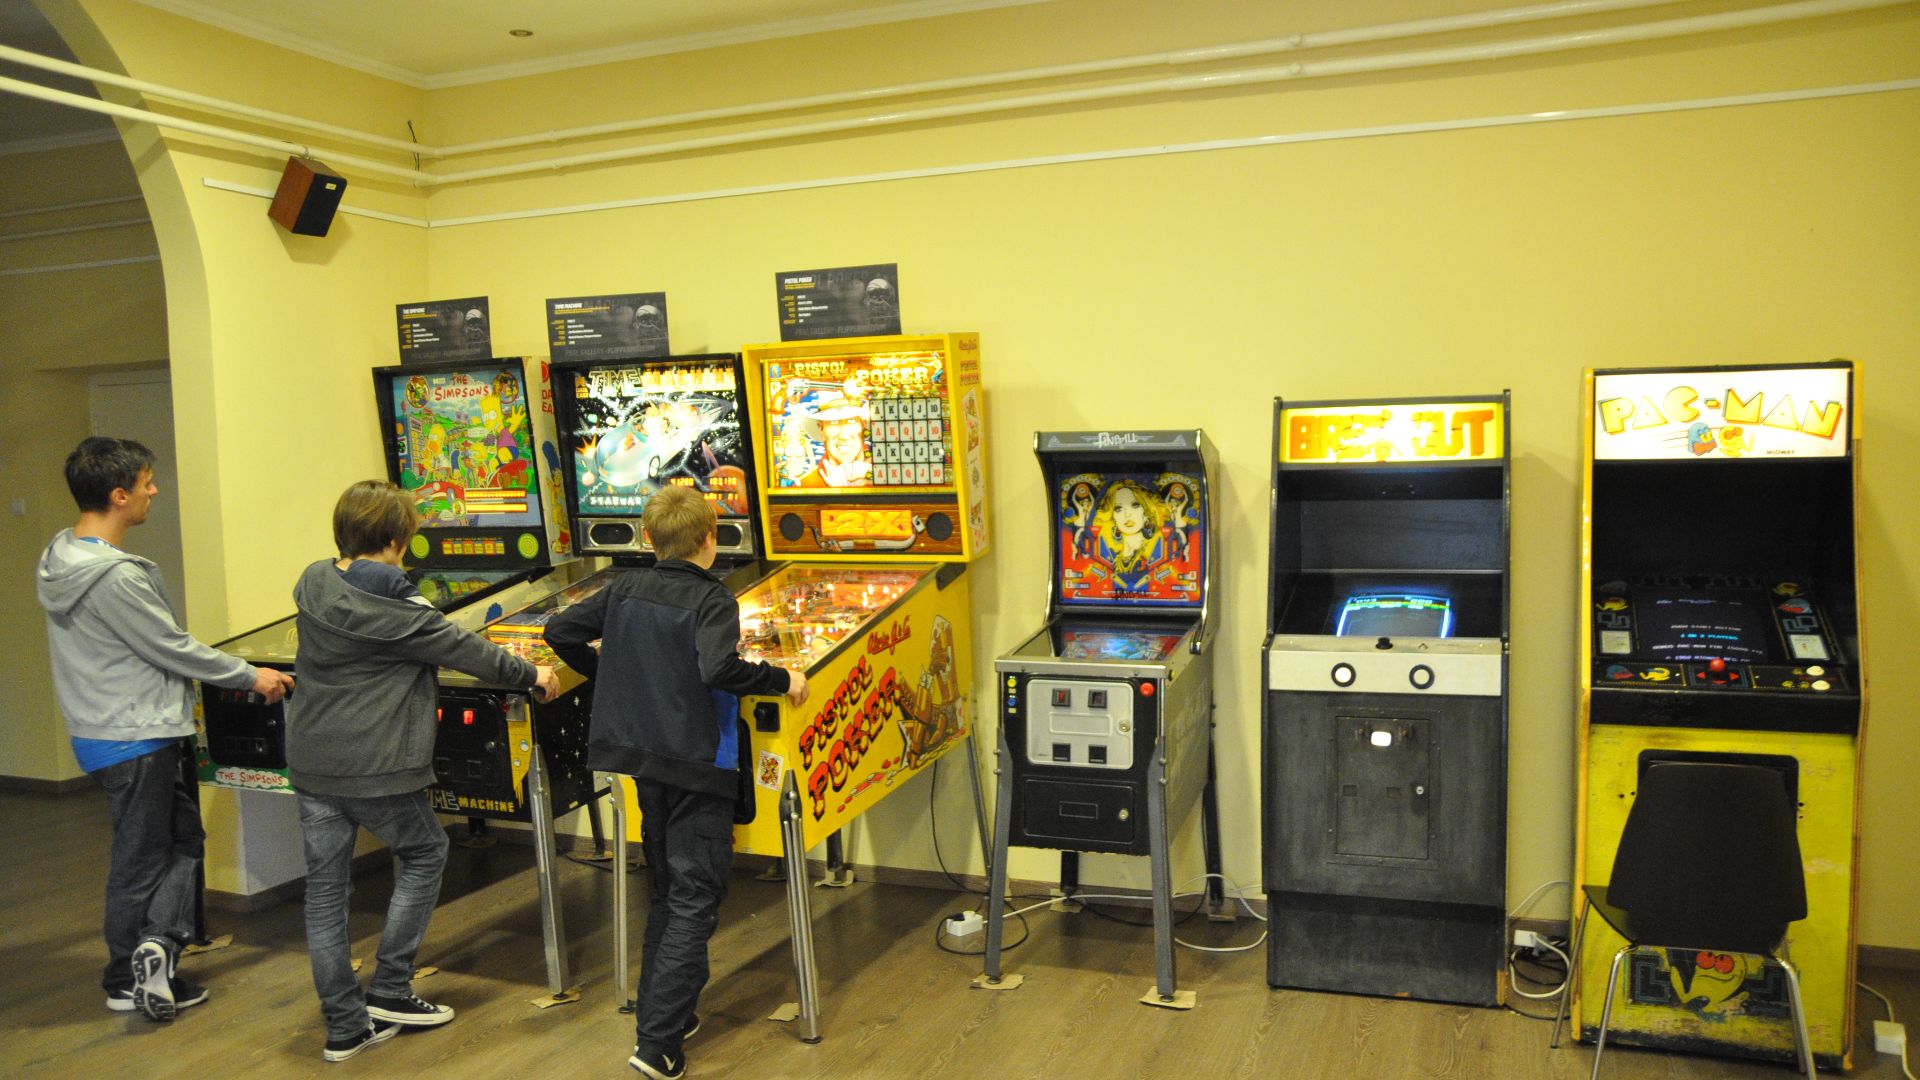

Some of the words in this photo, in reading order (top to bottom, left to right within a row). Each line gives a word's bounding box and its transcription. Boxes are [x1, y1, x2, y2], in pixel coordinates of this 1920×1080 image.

[794, 361, 847, 376] PISTOL
[856, 367, 929, 387] POKER
[452, 375, 468, 386] THE
[589, 369, 643, 398] TIME
[434, 385, 490, 401] SIMPSONS
[541, 390, 553, 401] DA
[541, 403, 554, 415] EA
[1598, 386, 1844, 441] PAC-MAN
[1290, 409, 1494, 461] BREOUT
[838, 511, 902, 535] 2X
[799, 654, 873, 771] PISTOL
[808, 667, 902, 822] POKER
[218, 771, 236, 781] THE
[240, 772, 284, 786] SIMPSONS
